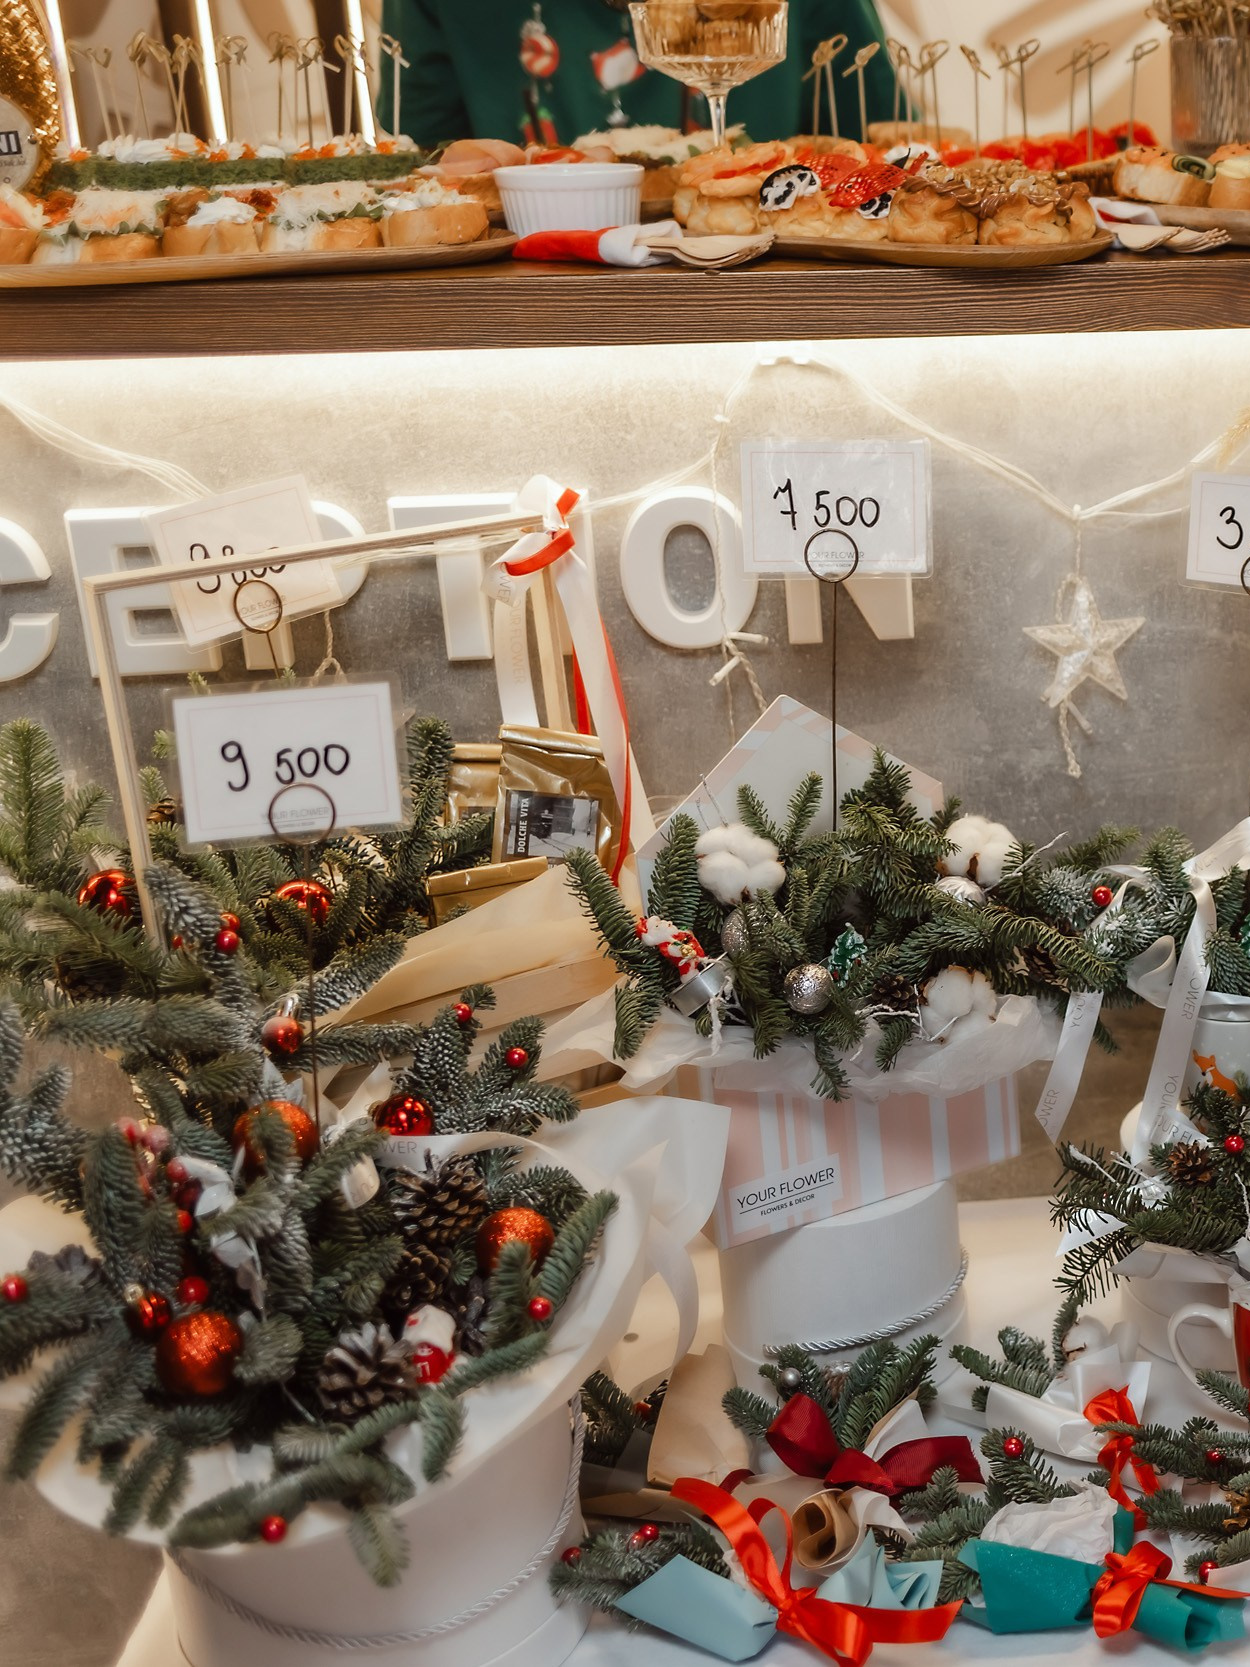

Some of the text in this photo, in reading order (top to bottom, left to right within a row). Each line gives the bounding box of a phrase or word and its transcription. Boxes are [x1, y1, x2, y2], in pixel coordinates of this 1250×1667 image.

[773, 478, 880, 530] 7 500
[1216, 505, 1243, 550] 3
[808, 551, 828, 559] OUR
[257, 595, 286, 609] FLOWR
[221, 740, 350, 792] 9 500
[517, 798, 530, 852] DOLCHE VITA
[1069, 992, 1087, 1029] YOU
[736, 1167, 835, 1209] YOUR FLOWER
[760, 1202, 788, 1216] FLOWERS
[795, 1193, 815, 1205] DECOR
